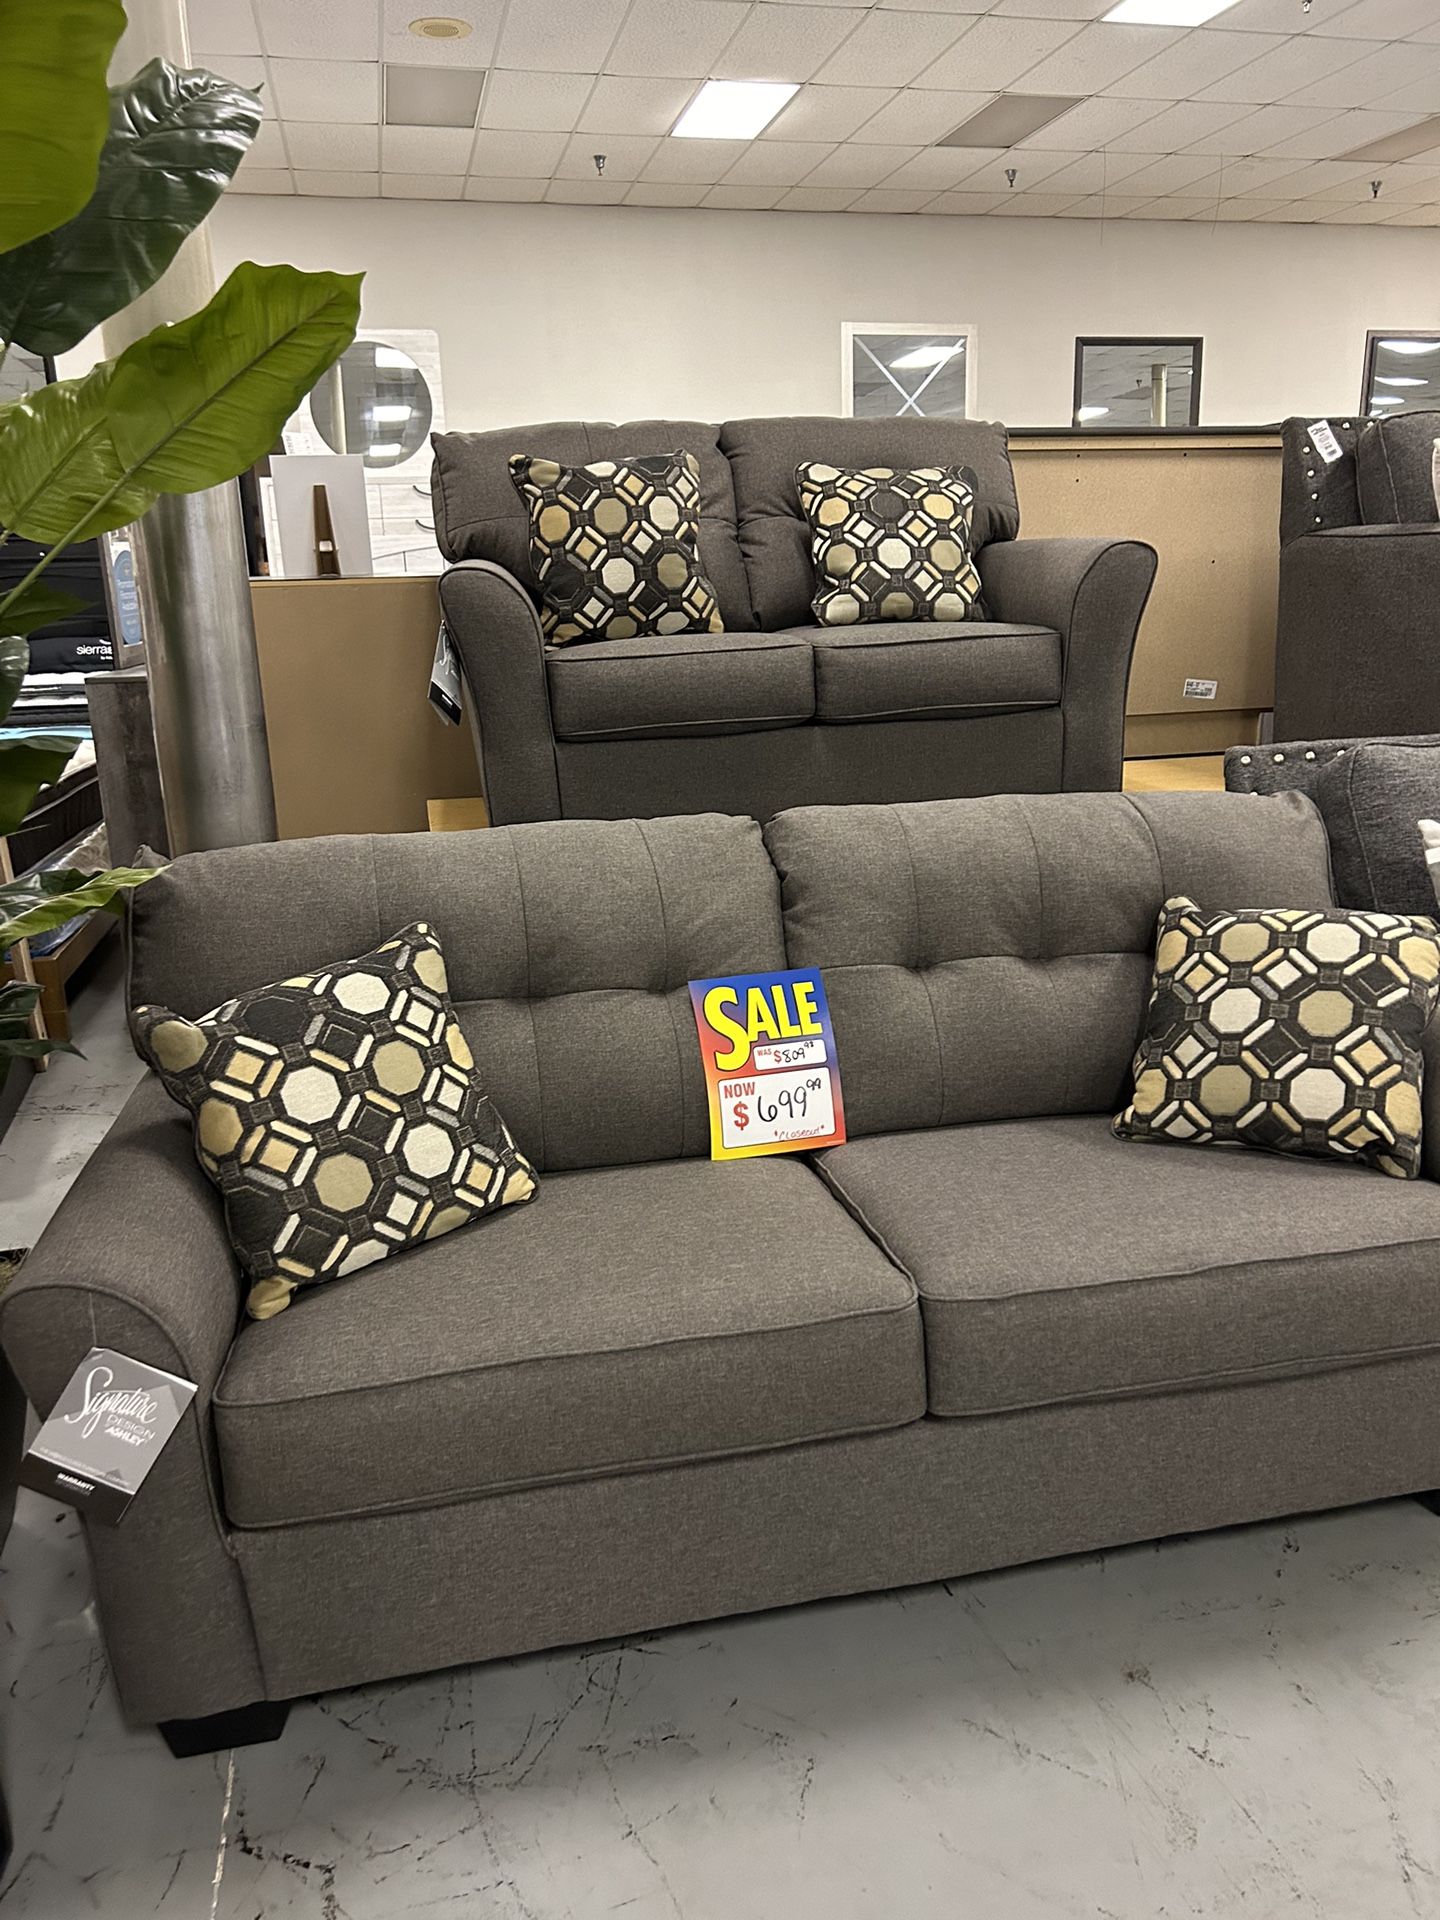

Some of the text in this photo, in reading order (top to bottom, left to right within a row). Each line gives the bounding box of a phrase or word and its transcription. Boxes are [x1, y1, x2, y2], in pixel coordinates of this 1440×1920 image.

[703, 981, 823, 1071] SALE
[757, 1048, 772, 1056] WAS
[723, 1081, 756, 1099] NOW
[63, 1366, 158, 1439] Signature
[104, 1426, 145, 1447] ASHLEY
[57, 1472, 96, 1491] WARRANTY
